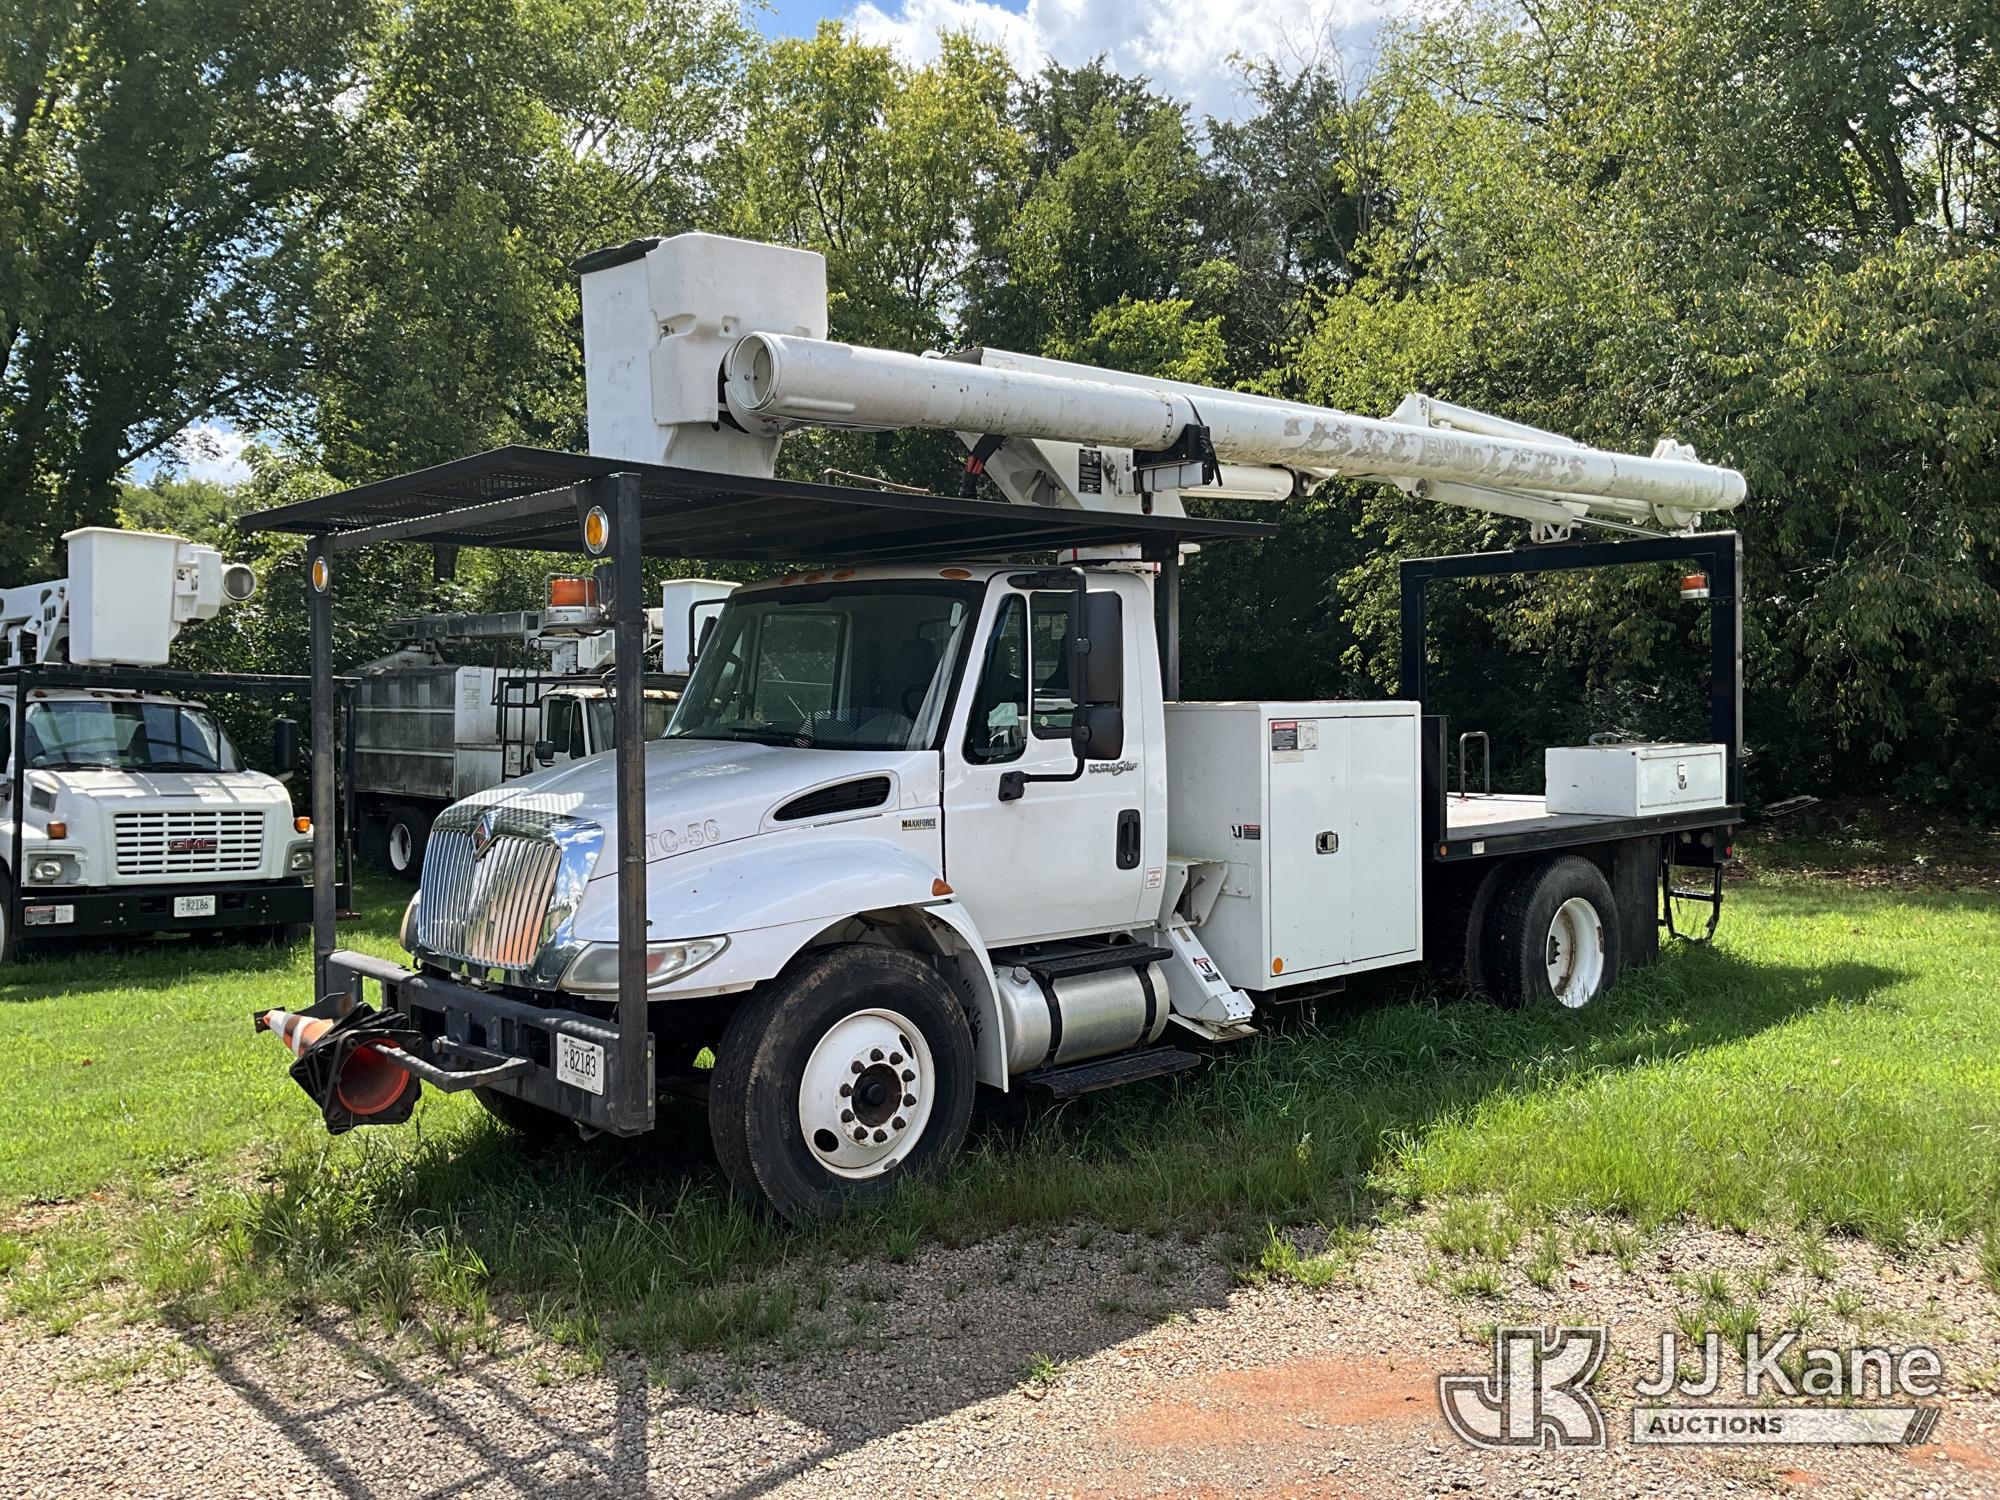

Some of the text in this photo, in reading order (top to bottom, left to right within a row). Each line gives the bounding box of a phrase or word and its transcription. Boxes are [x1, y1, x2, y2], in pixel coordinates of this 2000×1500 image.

[902, 818, 937, 827] MAXXFORCE
[170, 838, 217, 850] GMC
[646, 819, 721, 857] TC-56
[186, 900, 209, 910] 82186
[570, 1049, 596, 1077] 82183
